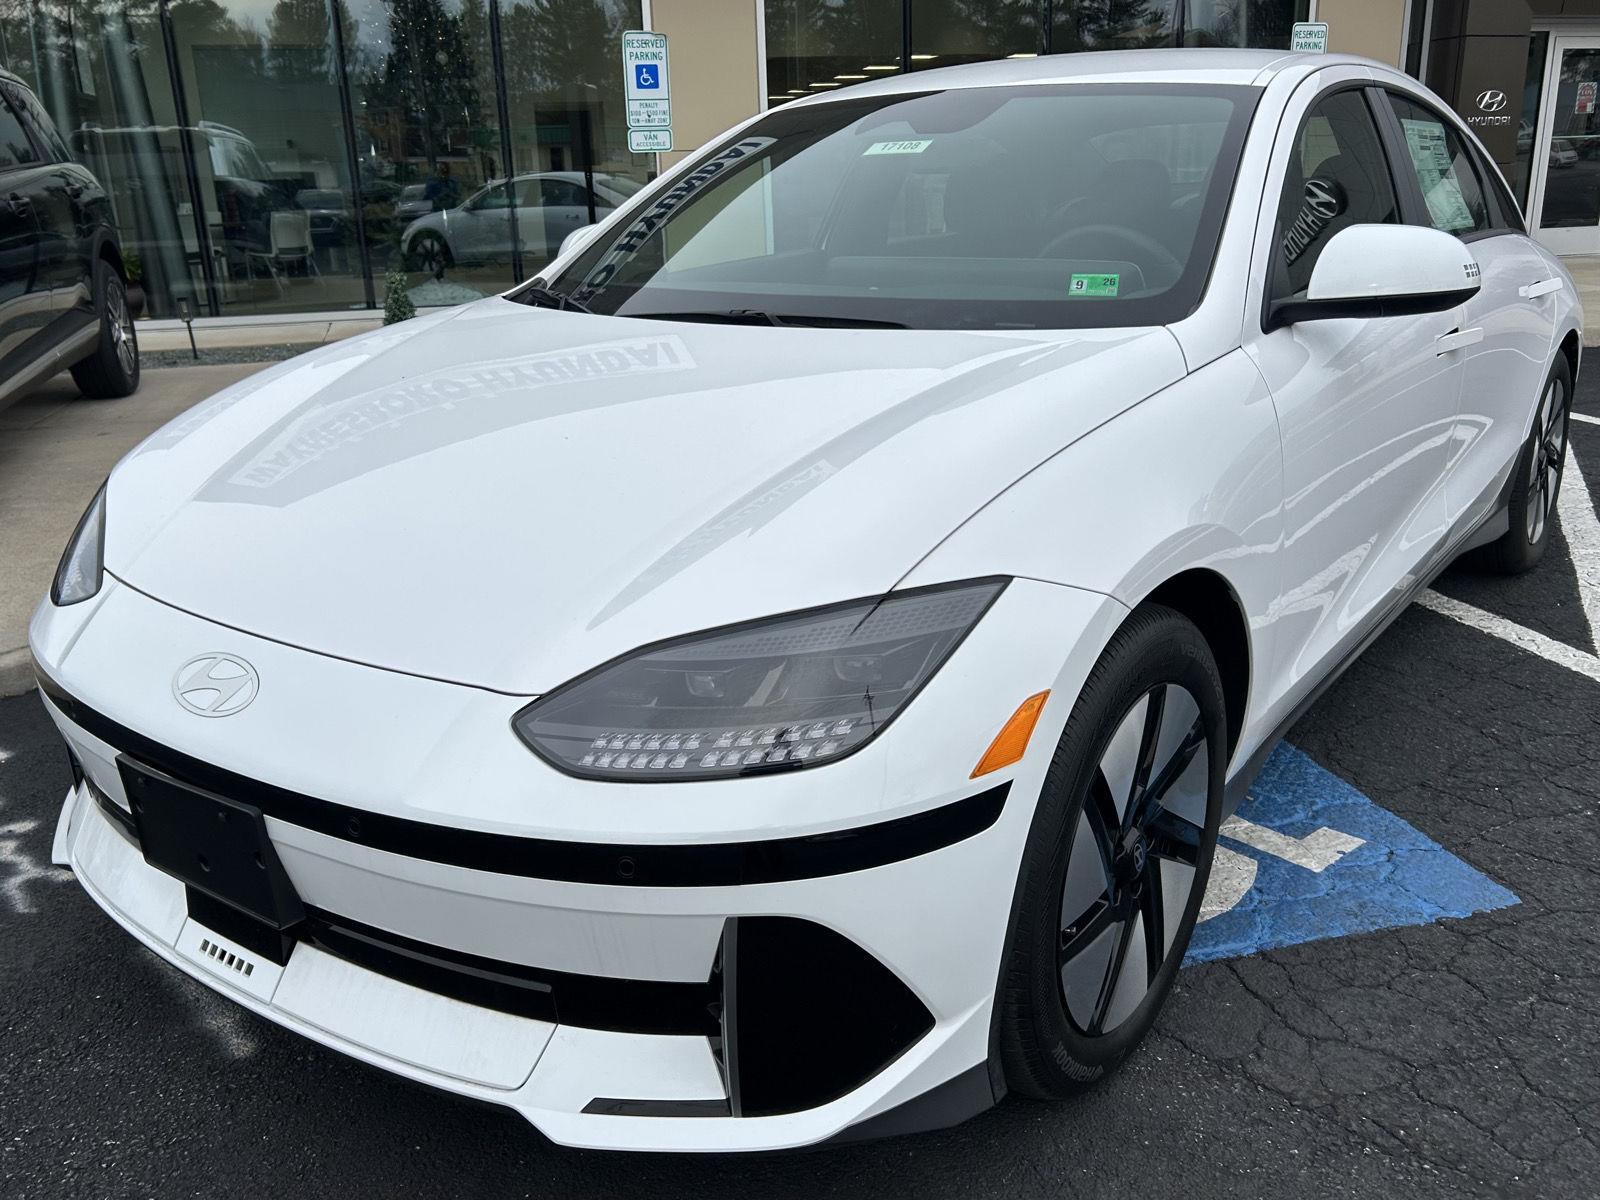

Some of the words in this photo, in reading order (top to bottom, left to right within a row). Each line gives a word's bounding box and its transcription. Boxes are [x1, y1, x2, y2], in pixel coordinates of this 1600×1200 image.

[1295, 30, 1325, 39] RESERVED
[626, 39, 665, 48] RESERVED
[1296, 41, 1322, 50] PARKING
[629, 51, 663, 61] PARKING
[1467, 115, 1512, 126] HYUNDAI
[881, 142, 922, 152] 17108
[1075, 280, 1084, 290] 9
[1103, 278, 1116, 286] 26
